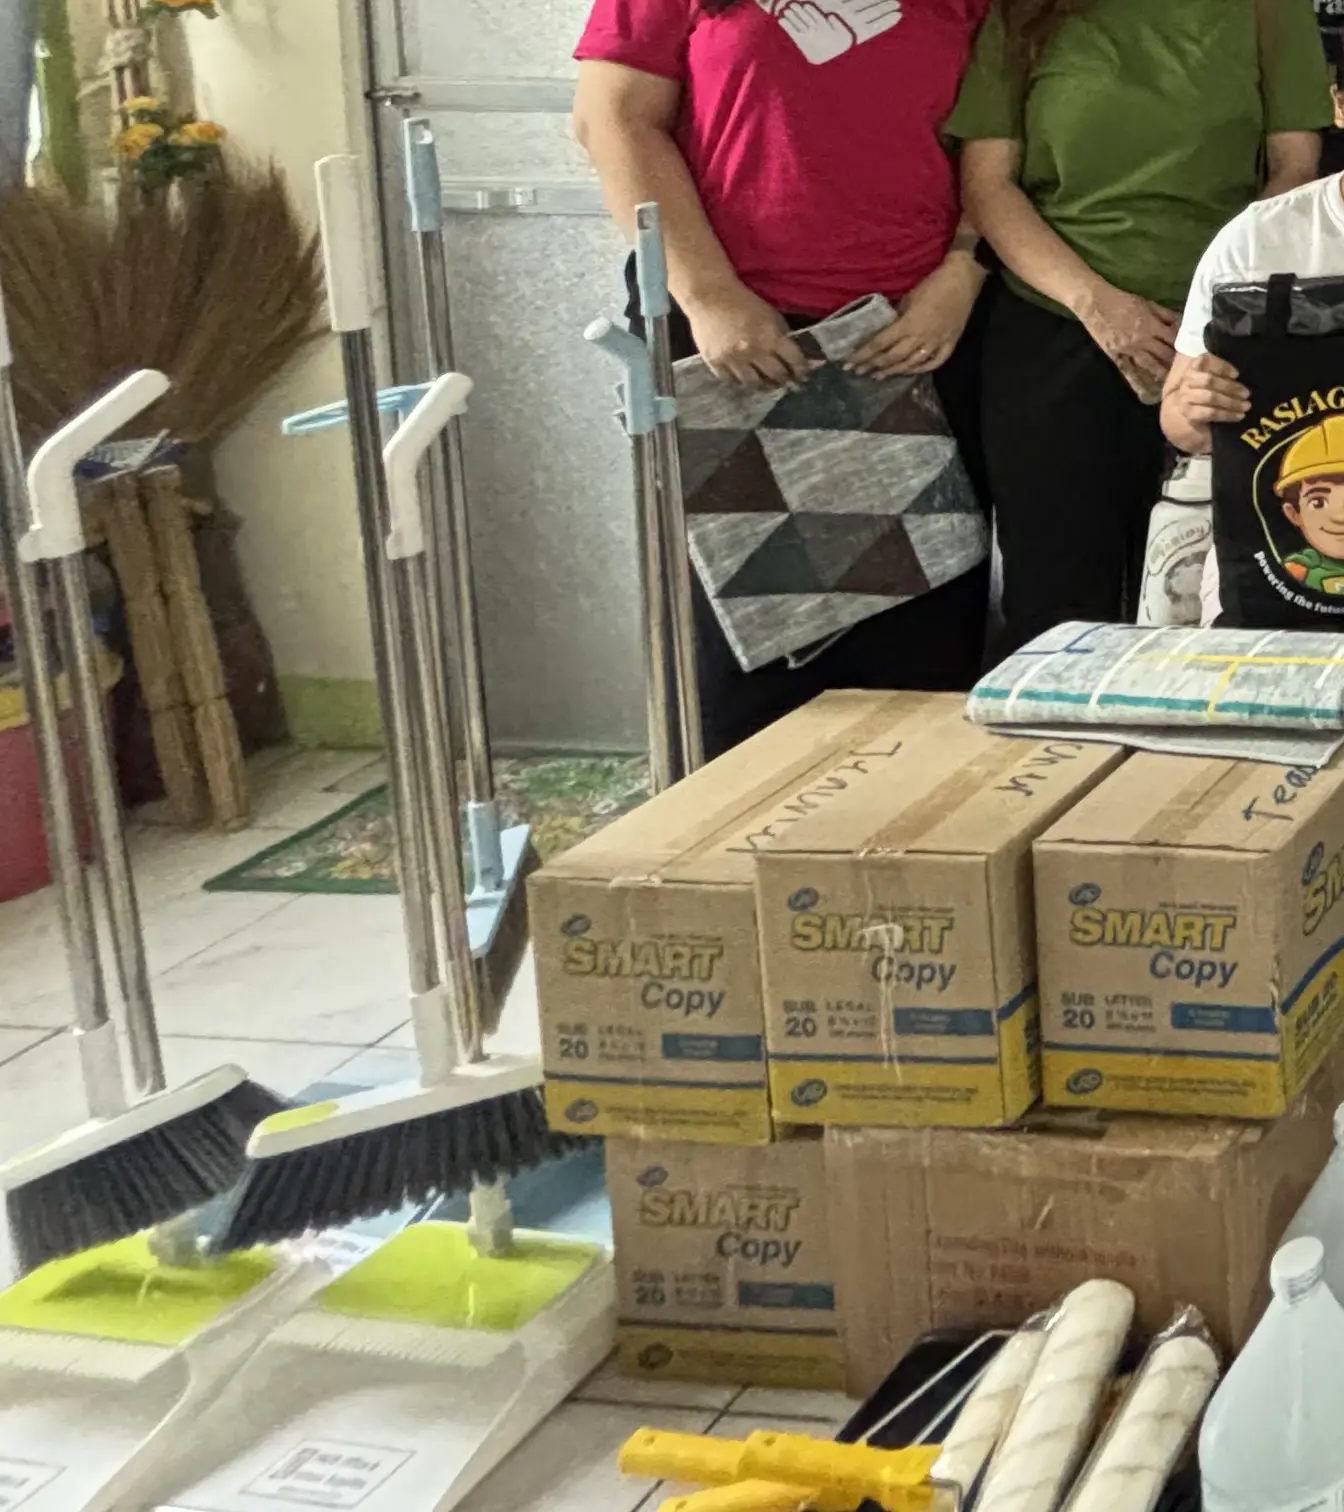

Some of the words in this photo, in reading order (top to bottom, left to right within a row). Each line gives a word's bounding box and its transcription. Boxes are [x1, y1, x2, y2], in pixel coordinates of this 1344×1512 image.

[1253, 550, 1295, 602] powering
[1294, 591, 1313, 611] the
[790, 912, 955, 954] SMART
[1069, 906, 1237, 953] SMART
[563, 936, 724, 982] SMART
[871, 954, 957, 992] Copy
[1150, 949, 1239, 989] Copy
[641, 981, 727, 1018] Copy
[784, 1016, 818, 1037] 20
[1062, 1009, 1096, 1030] 20
[559, 1038, 590, 1059] 20
[640, 1188, 803, 1232] SMART
[716, 1231, 803, 1268] Copy
